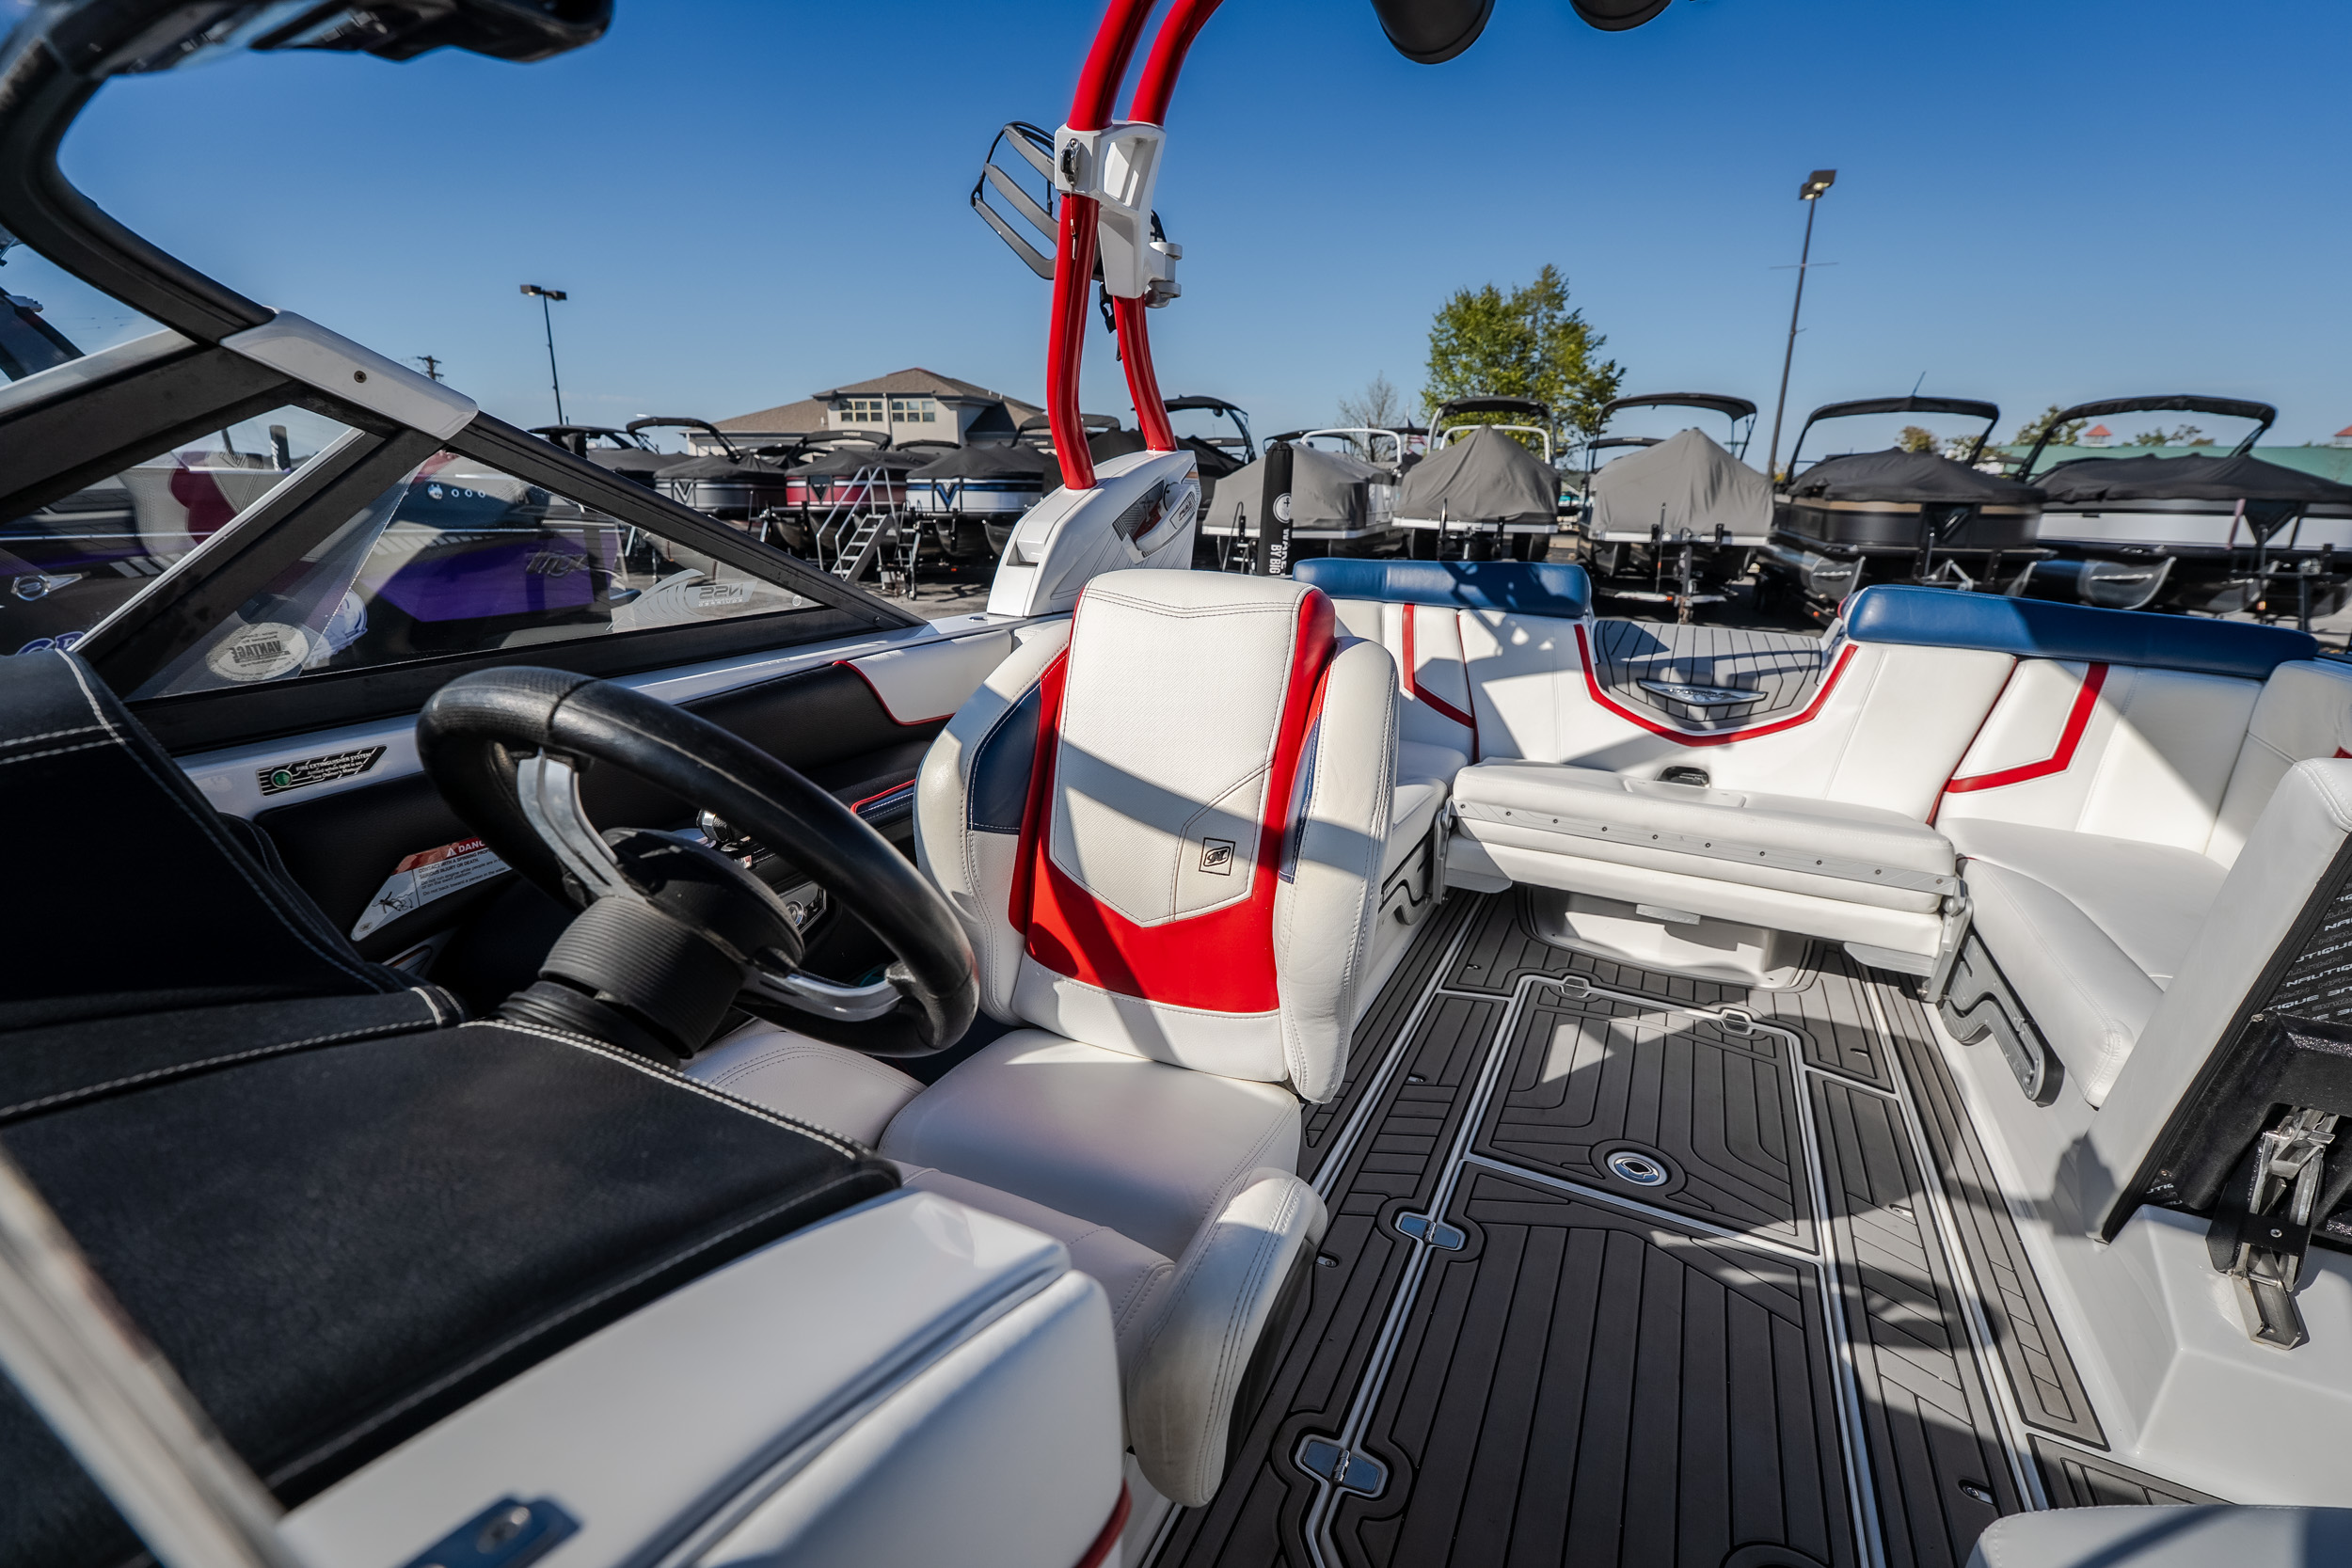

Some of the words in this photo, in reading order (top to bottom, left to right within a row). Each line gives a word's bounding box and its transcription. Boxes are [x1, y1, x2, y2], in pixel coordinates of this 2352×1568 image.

[1270, 544, 1282, 558] BY
[1269, 558, 1281, 574] BIG
[310, 756, 350, 768] EXTINGUISHER
[350, 752, 372, 762] SYSTEM
[458, 840, 485, 853] DAN
[440, 864, 456, 874] INJURY
[2286, 963, 2352, 987] NAUTIQ
[2267, 994, 2319, 1010] TIQUE
